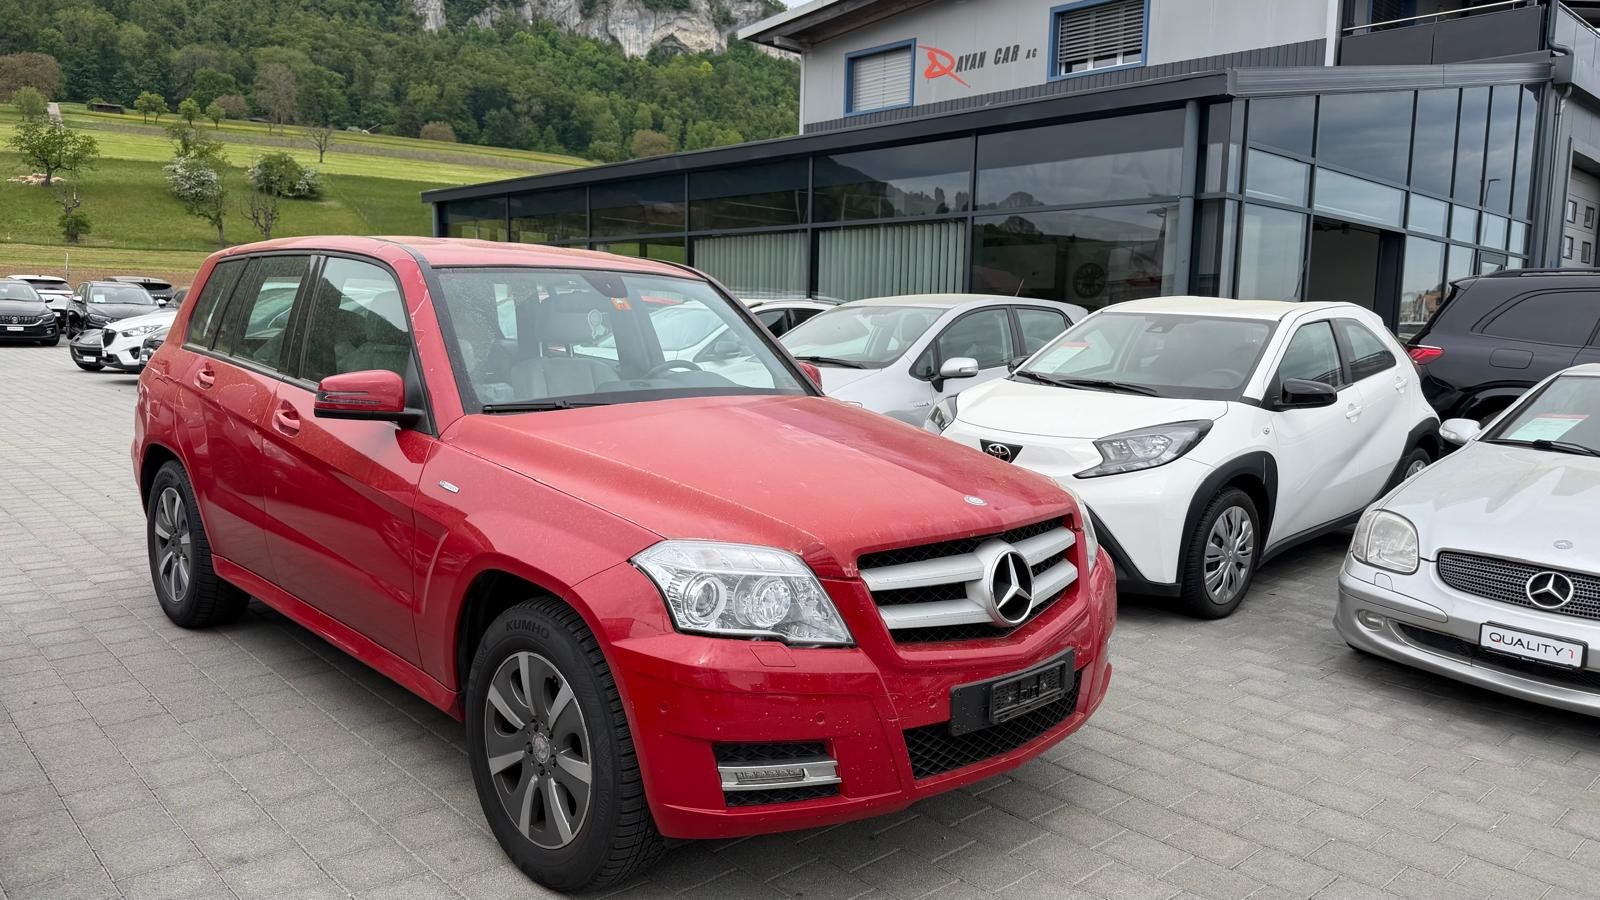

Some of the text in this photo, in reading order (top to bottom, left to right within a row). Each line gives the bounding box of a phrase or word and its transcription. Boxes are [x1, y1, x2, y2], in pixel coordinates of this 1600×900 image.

[993, 44, 1020, 65] CAR
[1025, 48, 1038, 59] AG
[505, 619, 550, 640] KUMHO
[1489, 632, 1564, 656] QUALITY
